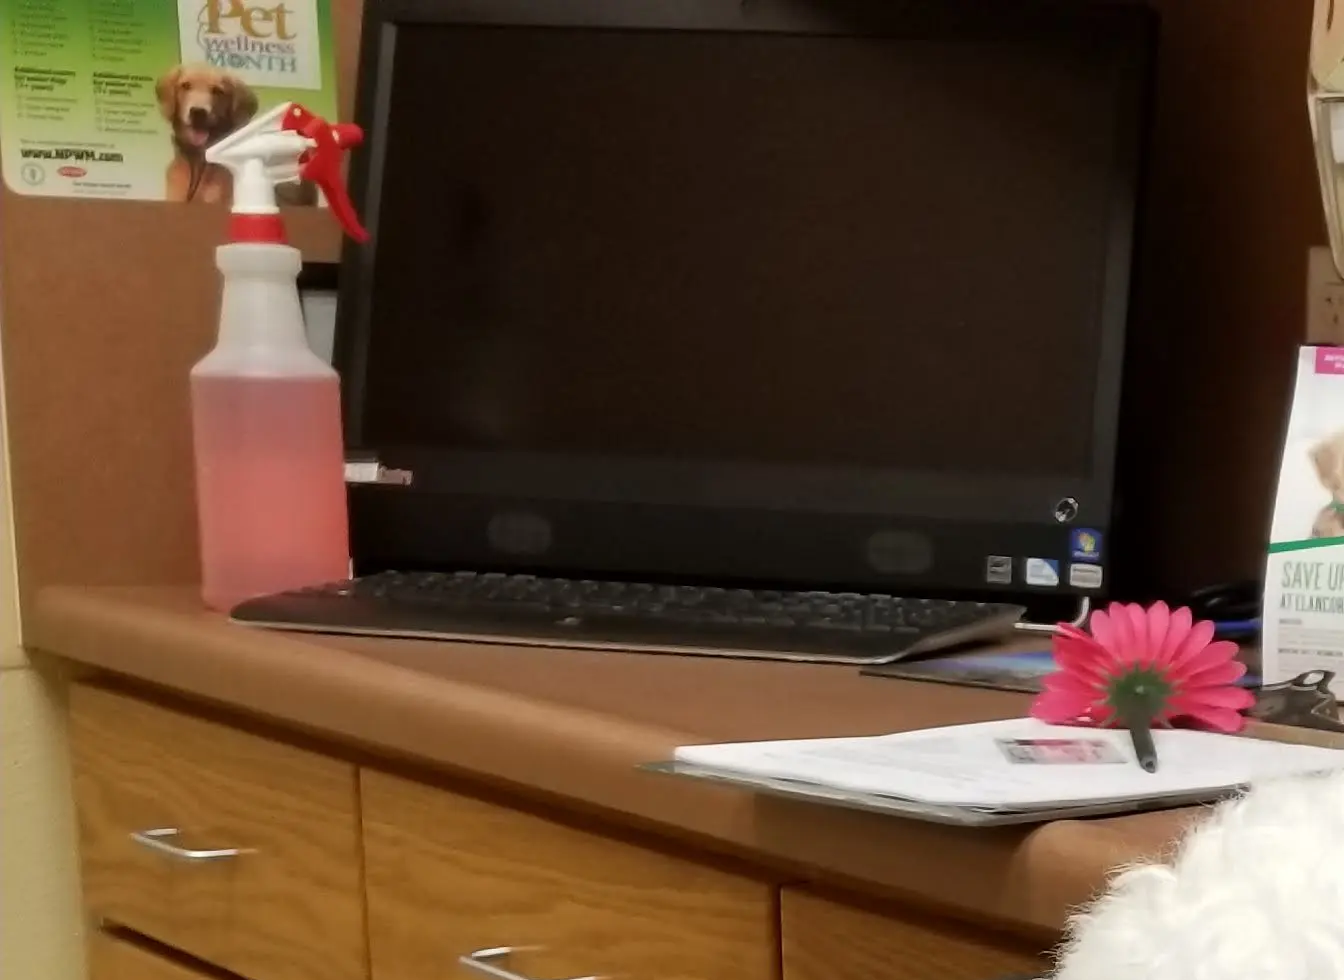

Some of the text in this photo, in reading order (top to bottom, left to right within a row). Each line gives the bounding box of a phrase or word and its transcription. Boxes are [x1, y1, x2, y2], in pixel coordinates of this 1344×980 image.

[205, 0, 297, 40] Pet
[203, 35, 295, 54] wellness
[205, 49, 297, 73] MONTH
[1280, 560, 1324, 592] SAVE
